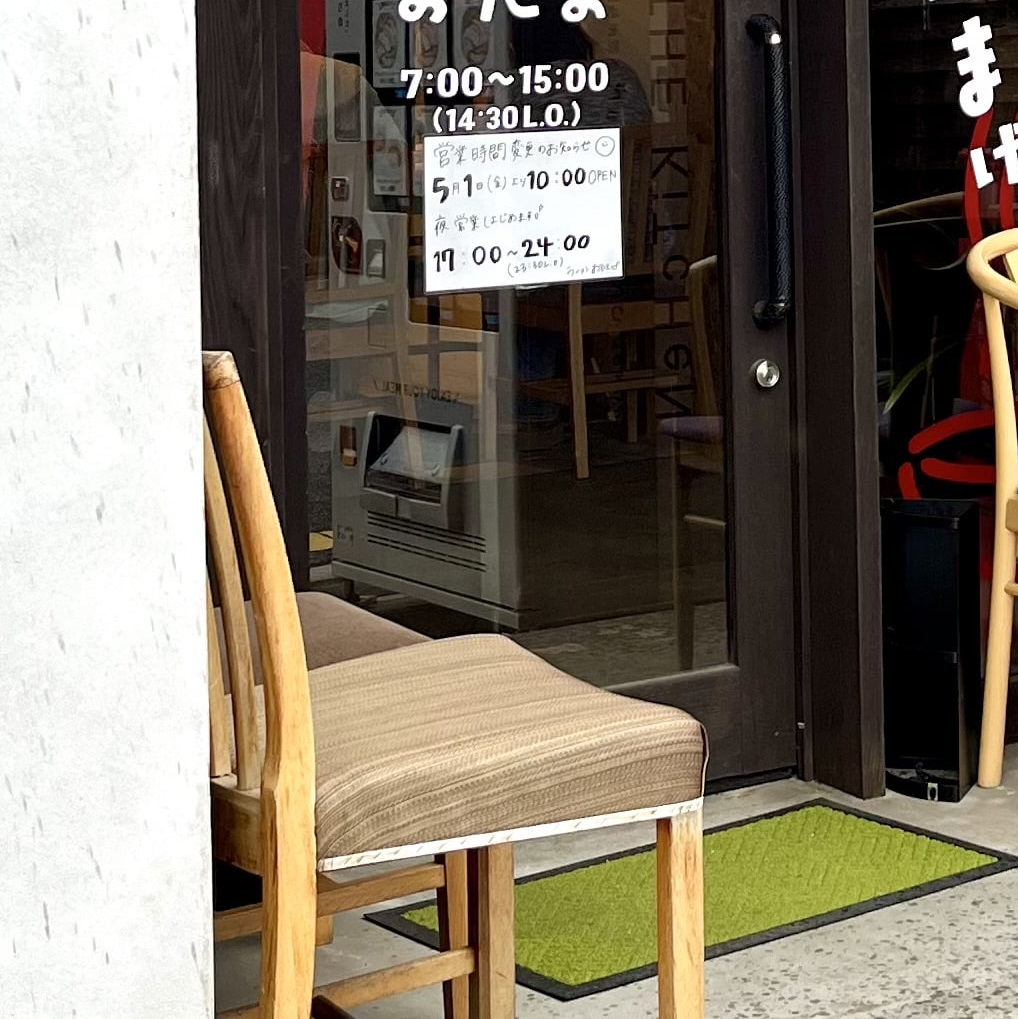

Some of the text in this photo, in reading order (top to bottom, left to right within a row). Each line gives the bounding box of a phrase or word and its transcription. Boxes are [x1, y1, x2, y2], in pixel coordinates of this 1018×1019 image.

[434, 138, 591, 169] 営業時間変更のお知らせ
